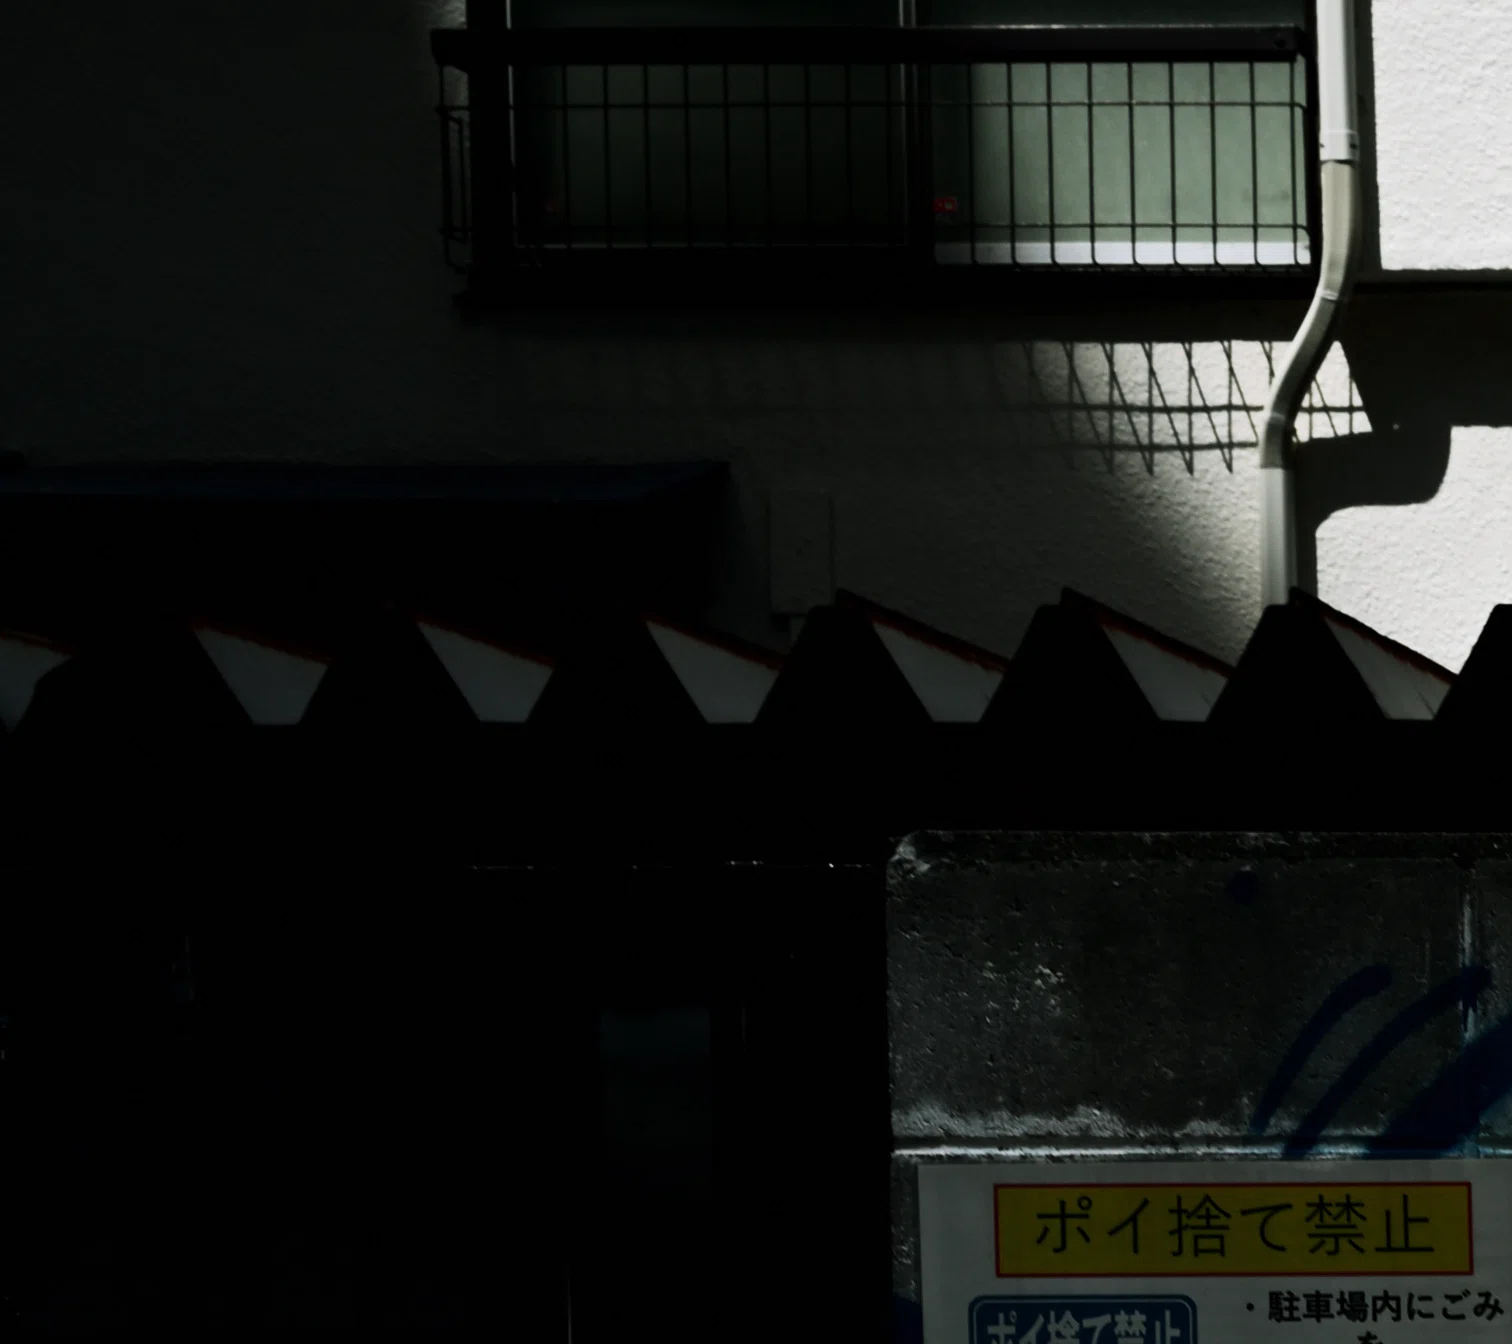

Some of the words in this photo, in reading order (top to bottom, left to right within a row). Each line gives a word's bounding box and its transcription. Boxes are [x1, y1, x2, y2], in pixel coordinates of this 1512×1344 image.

[1036, 1193, 1435, 1258] ポイ捨て禁止
